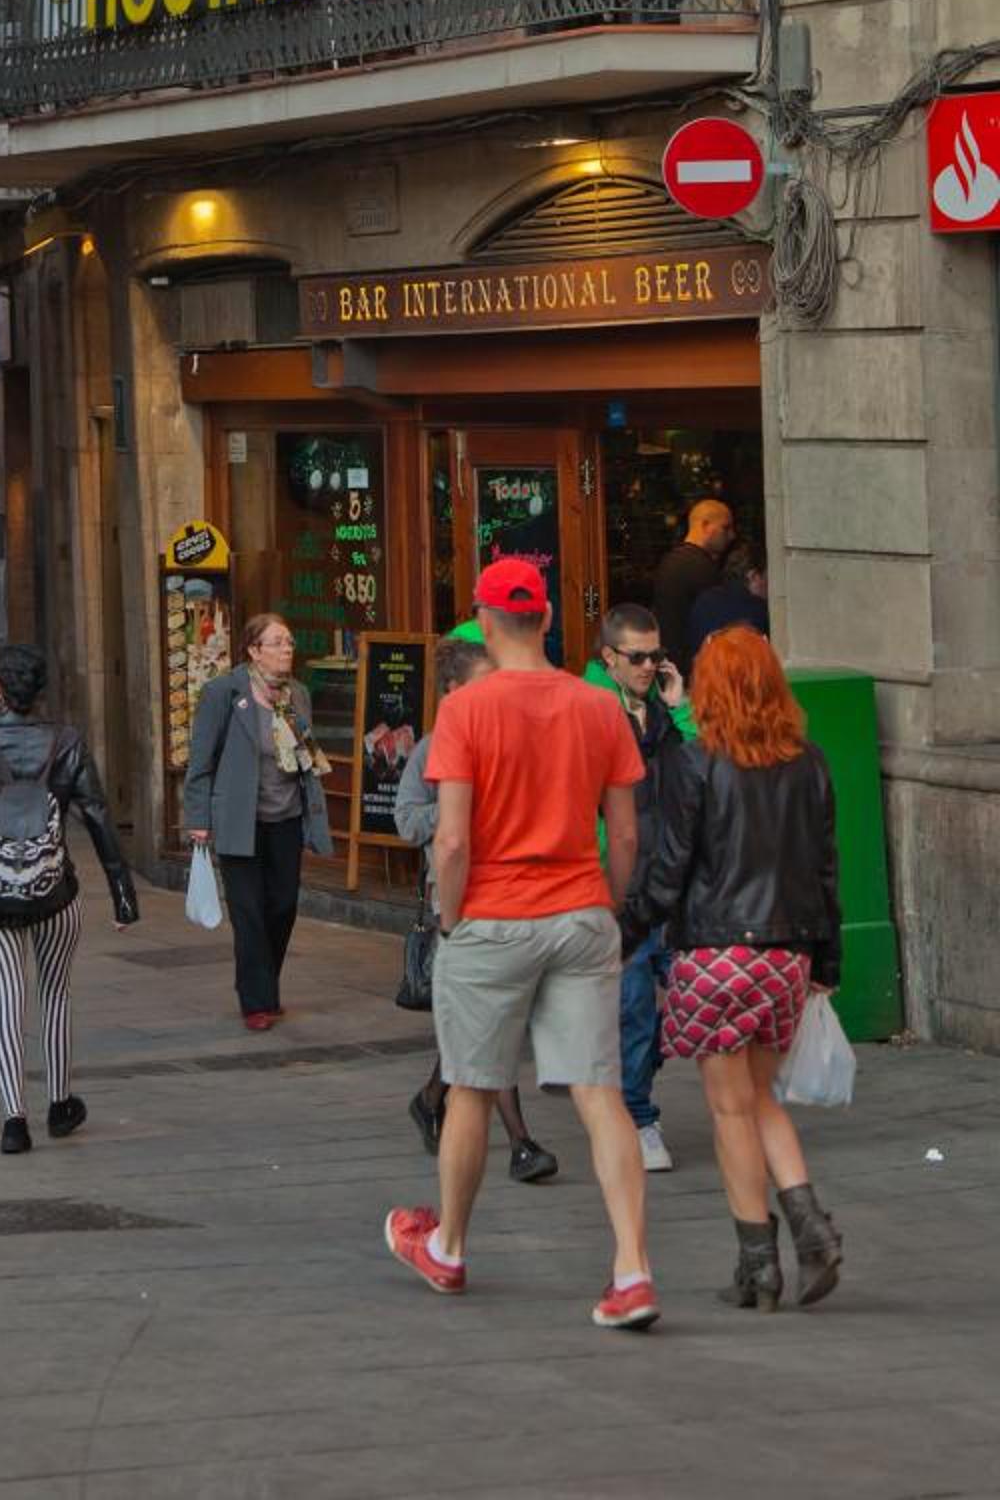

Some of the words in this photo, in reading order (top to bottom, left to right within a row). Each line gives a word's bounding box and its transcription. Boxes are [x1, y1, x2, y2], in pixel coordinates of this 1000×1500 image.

[339, 286, 388, 322] BAR
[403, 269, 617, 318] INTERNATIONAL
[635, 261, 714, 303] BEER
[488, 476, 541, 501] Today
[349, 490, 361, 521] 5
